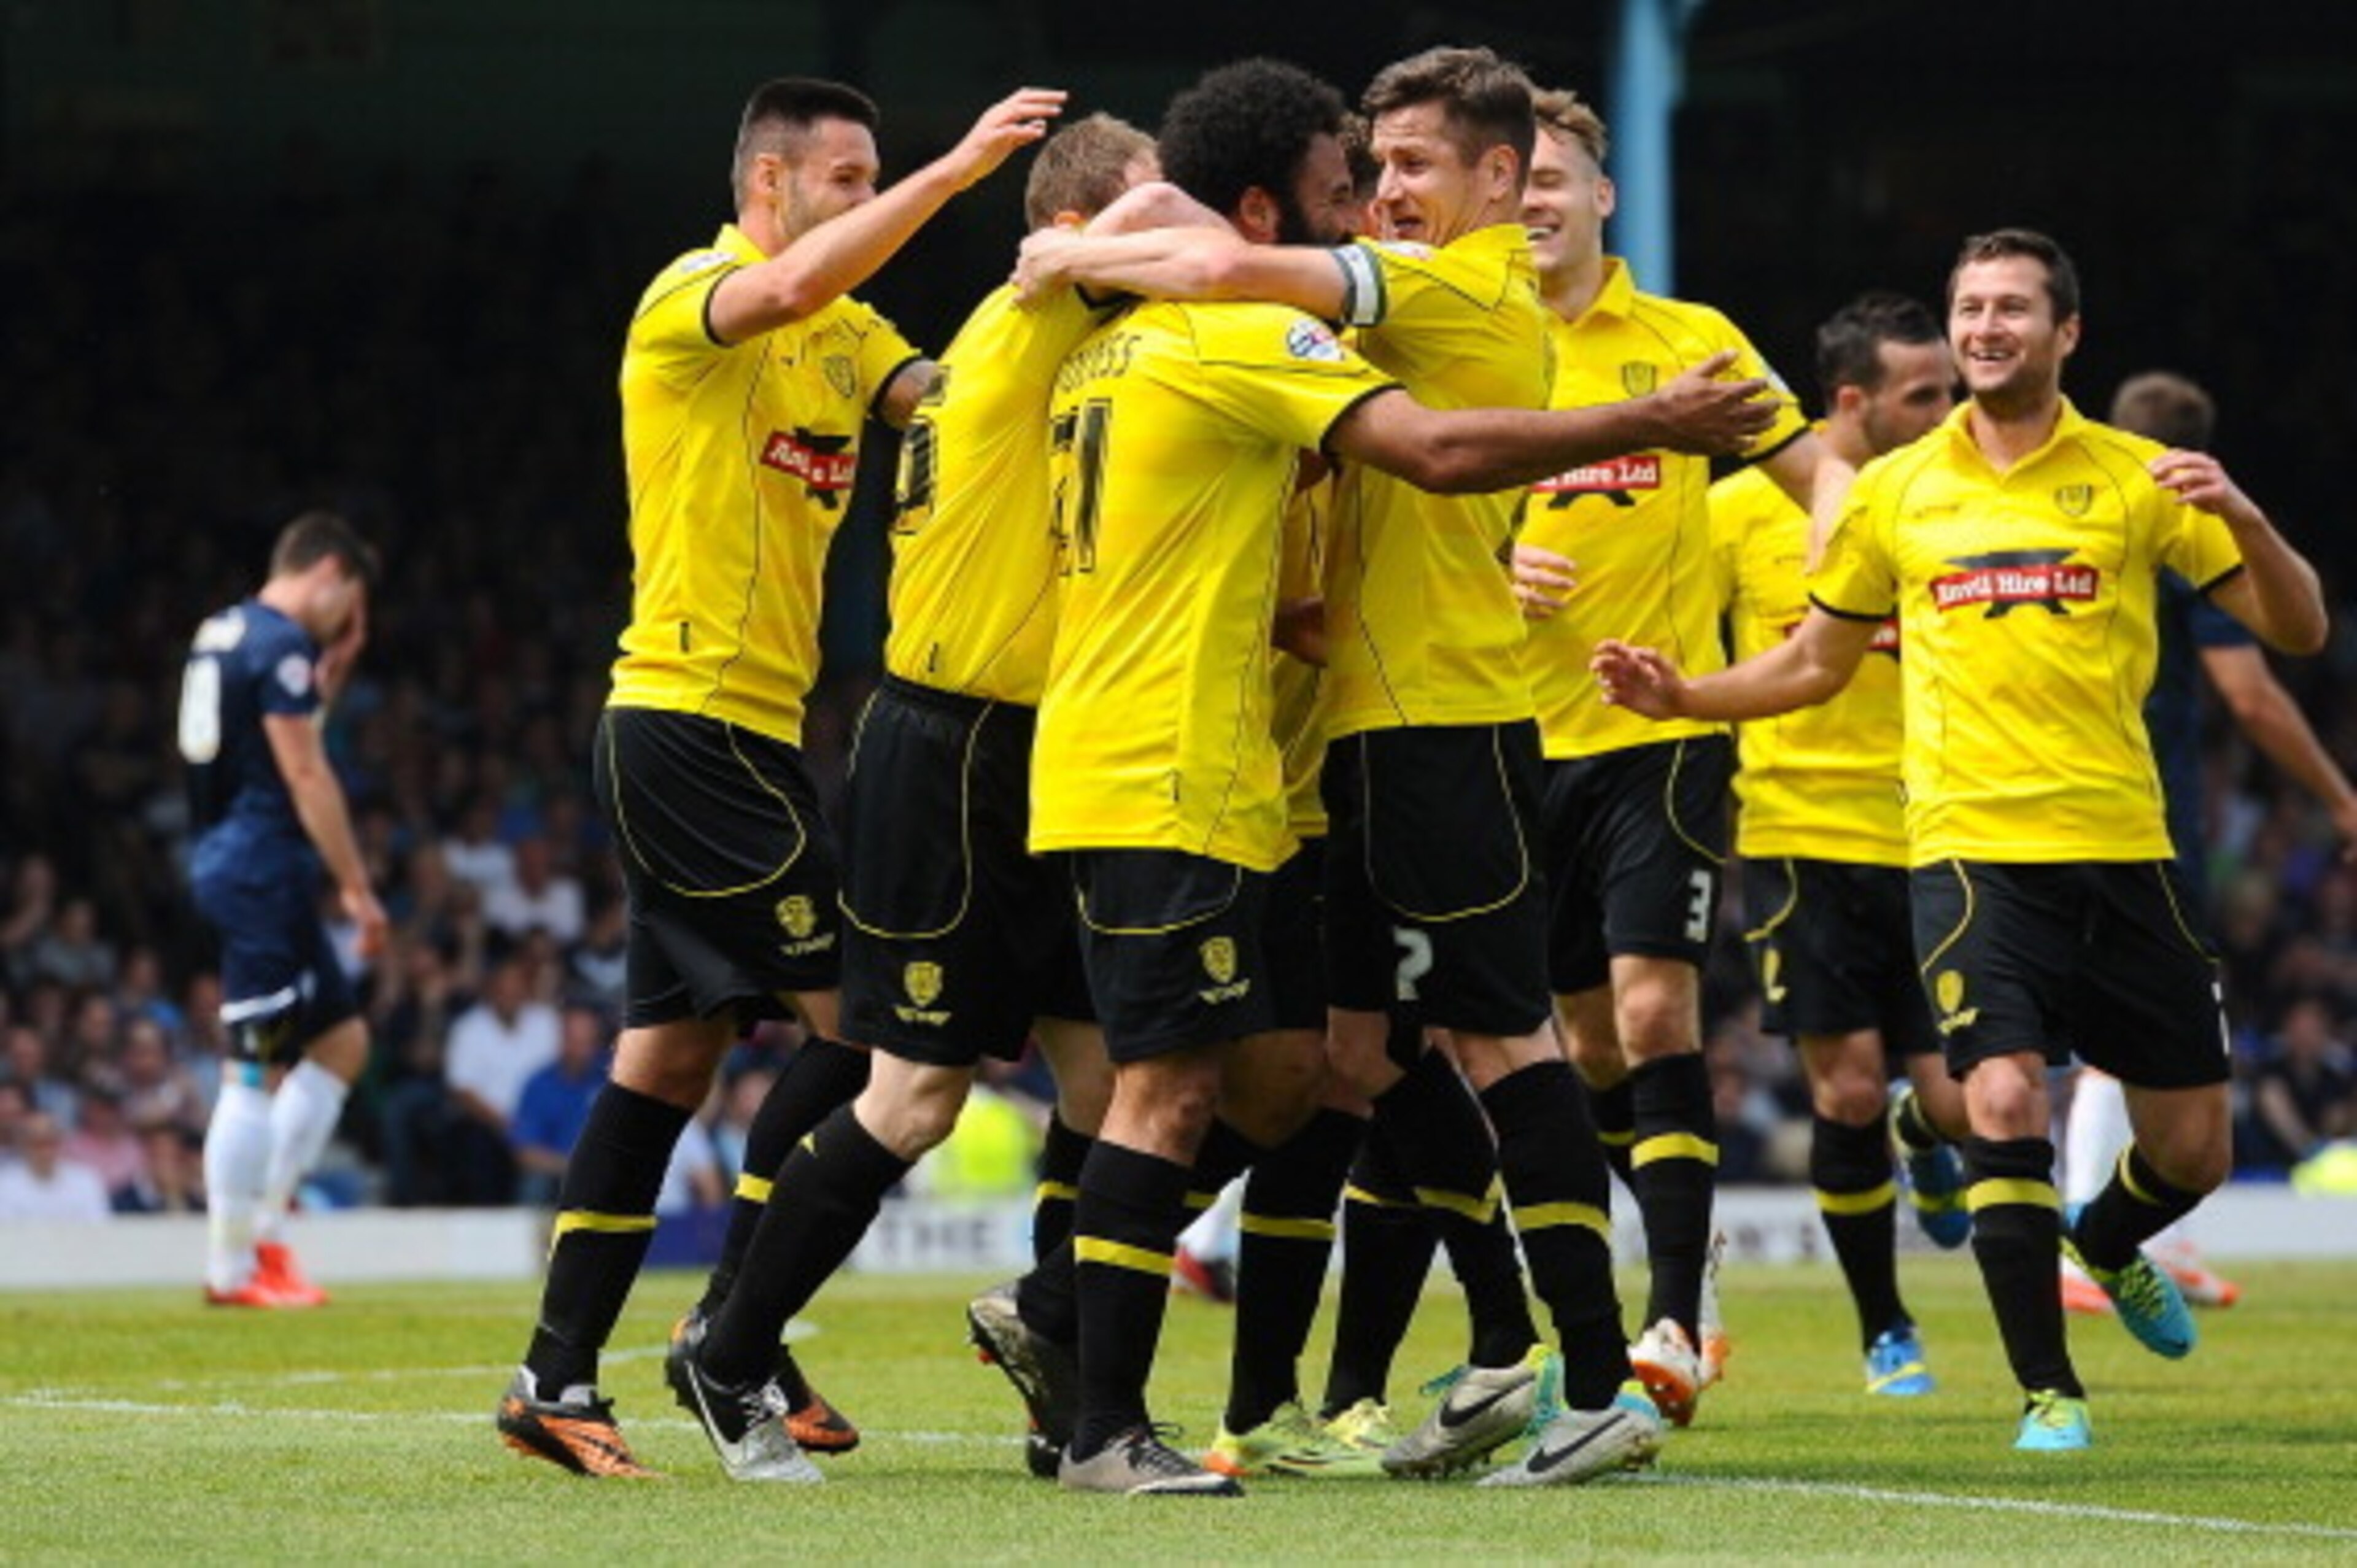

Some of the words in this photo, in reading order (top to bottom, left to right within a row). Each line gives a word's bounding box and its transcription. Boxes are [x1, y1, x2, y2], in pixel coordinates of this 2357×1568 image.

[1619, 463, 1657, 482] Ltd
[1997, 571, 2049, 595] Hire
[2053, 571, 2092, 594] Ltd
[1684, 870, 1712, 943] 3
[1393, 925, 1433, 1001] 2
